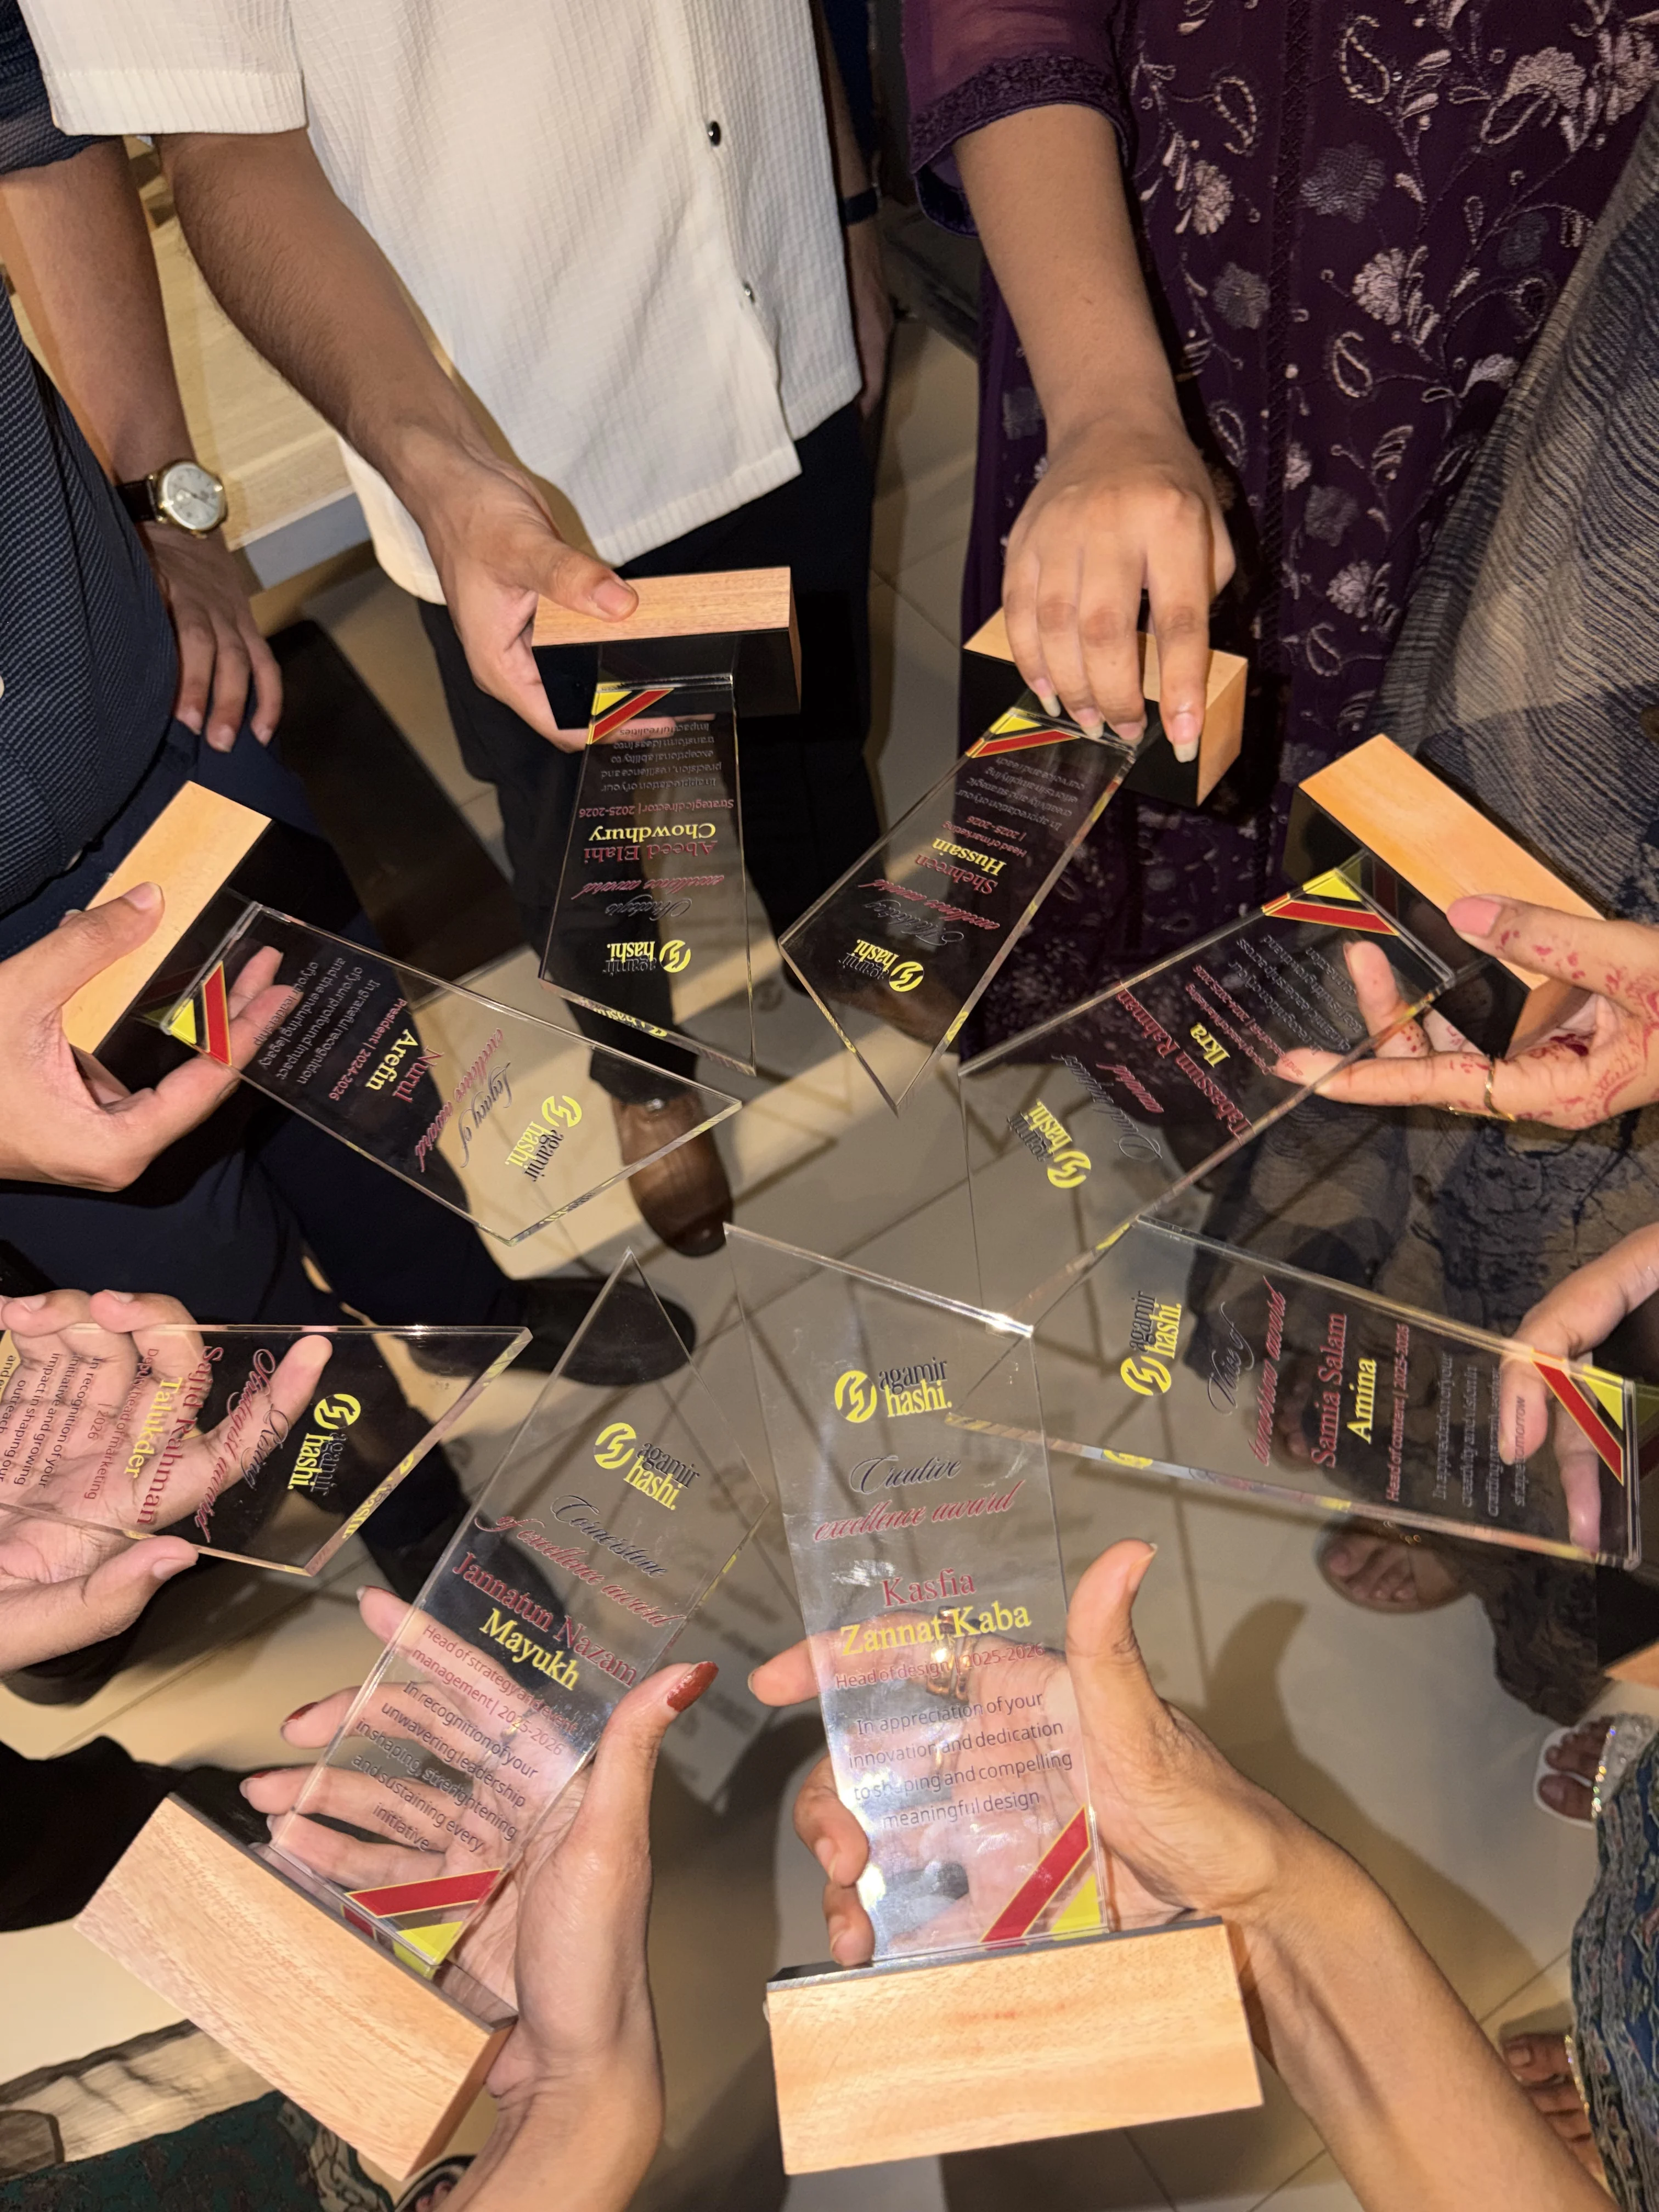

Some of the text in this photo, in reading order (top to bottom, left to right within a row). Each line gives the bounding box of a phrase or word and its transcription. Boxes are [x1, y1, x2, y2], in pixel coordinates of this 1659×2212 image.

[578, 805, 635, 817] 2025-2026
[588, 822, 716, 842] Chowdhury
[642, 802, 684, 811] director
[685, 799, 734, 810] Strategic
[583, 840, 718, 864] Abeed Elahi
[933, 837, 1007, 876] Hussain
[940, 820, 1028, 857] Head of marketing
[571, 875, 724, 899] excellence award
[914, 854, 997, 894] Shehreen
[605, 894, 692, 921] Strategic
[857, 878, 1000, 929] excellence award
[602, 955, 657, 976] agamir
[607, 941, 655, 963] hashi.
[837, 952, 890, 980] agamir
[850, 939, 900, 972] hashi.
[251, 960, 321, 1047] of your leadership
[257, 956, 348, 1068] and the enduring legacy
[274, 965, 366, 1080] of your profound impact
[367, 997, 408, 1044] President
[295, 978, 381, 1086] In grateful recognition
[364, 1028, 418, 1090] Arefin
[1187, 1022, 1231, 1068] Ikra
[327, 1047, 372, 1102] 2024-2026
[391, 1044, 444, 1103] Nurul
[1096, 1063, 1164, 1111] award
[1113, 988, 1253, 1138] Tabassum Rahman
[414, 1028, 506, 1173] excellence award
[456, 1062, 512, 1169] Legacy of
[1023, 1100, 1073, 1153] hashi.
[504, 1120, 553, 1169] hashi.
[523, 1128, 565, 1182] agamir
[1007, 1112, 1054, 1162] agamir
[1092, 1107, 1162, 1163] Dual
[1130, 1290, 1156, 1353] agamir
[1144, 1302, 1182, 1359] hashi.
[0, 1355, 16, 1378] and
[878, 1356, 946, 1395] agamir
[1207, 1301, 1254, 1415] Voice of
[1251, 1274, 1285, 1466] tomorrow award
[1392, 1322, 1410, 1390] 2025-2026
[0, 1380, 27, 1434] outreach
[884, 1379, 952, 1418] hashi.
[1310, 1310, 1347, 1468] Samia Salam
[1346, 1356, 1376, 1444] Amina
[0, 1353, 62, 1482] impact in shaping our
[13, 1356, 81, 1485] initiative and growing
[37, 1357, 103, 1488] In recognition of your
[83, 1348, 159, 1500] Deputy head of marketing
[86, 1409, 109, 1440] 2026
[123, 1377, 183, 1479] Talukder
[136, 1345, 225, 1524] Sajid Rahman
[194, 1348, 274, 1542] Strategist award
[1390, 1397, 1405, 1449] content
[240, 1403, 288, 1491] Rising
[286, 1432, 333, 1490] hashi.
[309, 1432, 347, 1496] agamir
[635, 1441, 701, 1489] agamir
[1387, 1446, 1402, 1464] of
[623, 1454, 682, 1511] hashi.
[850, 1455, 961, 1495] Creative
[1385, 1463, 1401, 1502] Head
[550, 1494, 667, 1578] Cornerstone
[814, 1480, 1025, 1542] excellence award
[473, 1517, 686, 1629] of excellence award
[879, 1567, 977, 1608] Kasfia
[452, 1549, 640, 1689] Jannatun Nazam
[839, 1600, 1032, 1656] Zannat Kaba
[479, 1606, 578, 1691] Mayukh
[835, 1669, 877, 1690] Head
[878, 1665, 898, 1682] of
[896, 1658, 950, 1679] design
[962, 1642, 1046, 1669] 2025-2026
[411, 1647, 494, 1708] management
[497, 1705, 565, 1757] 2025-2026
[421, 1623, 578, 1736] Head of strategy and event
[403, 1680, 539, 1780] In recognition of your
[856, 1692, 1043, 1735] In appreciation of your
[356, 1717, 373, 1736] in
[366, 1725, 425, 1777] shaping,
[380, 1701, 527, 1808] unwavering leadership
[848, 1718, 1063, 1769] innovation and dedication
[351, 1751, 484, 1852] and sustaining every
[854, 1785, 870, 1801] to
[944, 1766, 976, 1786] and
[978, 1751, 1073, 1780] compelling
[371, 1801, 433, 1852] initiative
[881, 1789, 1040, 1829] meaningful design
